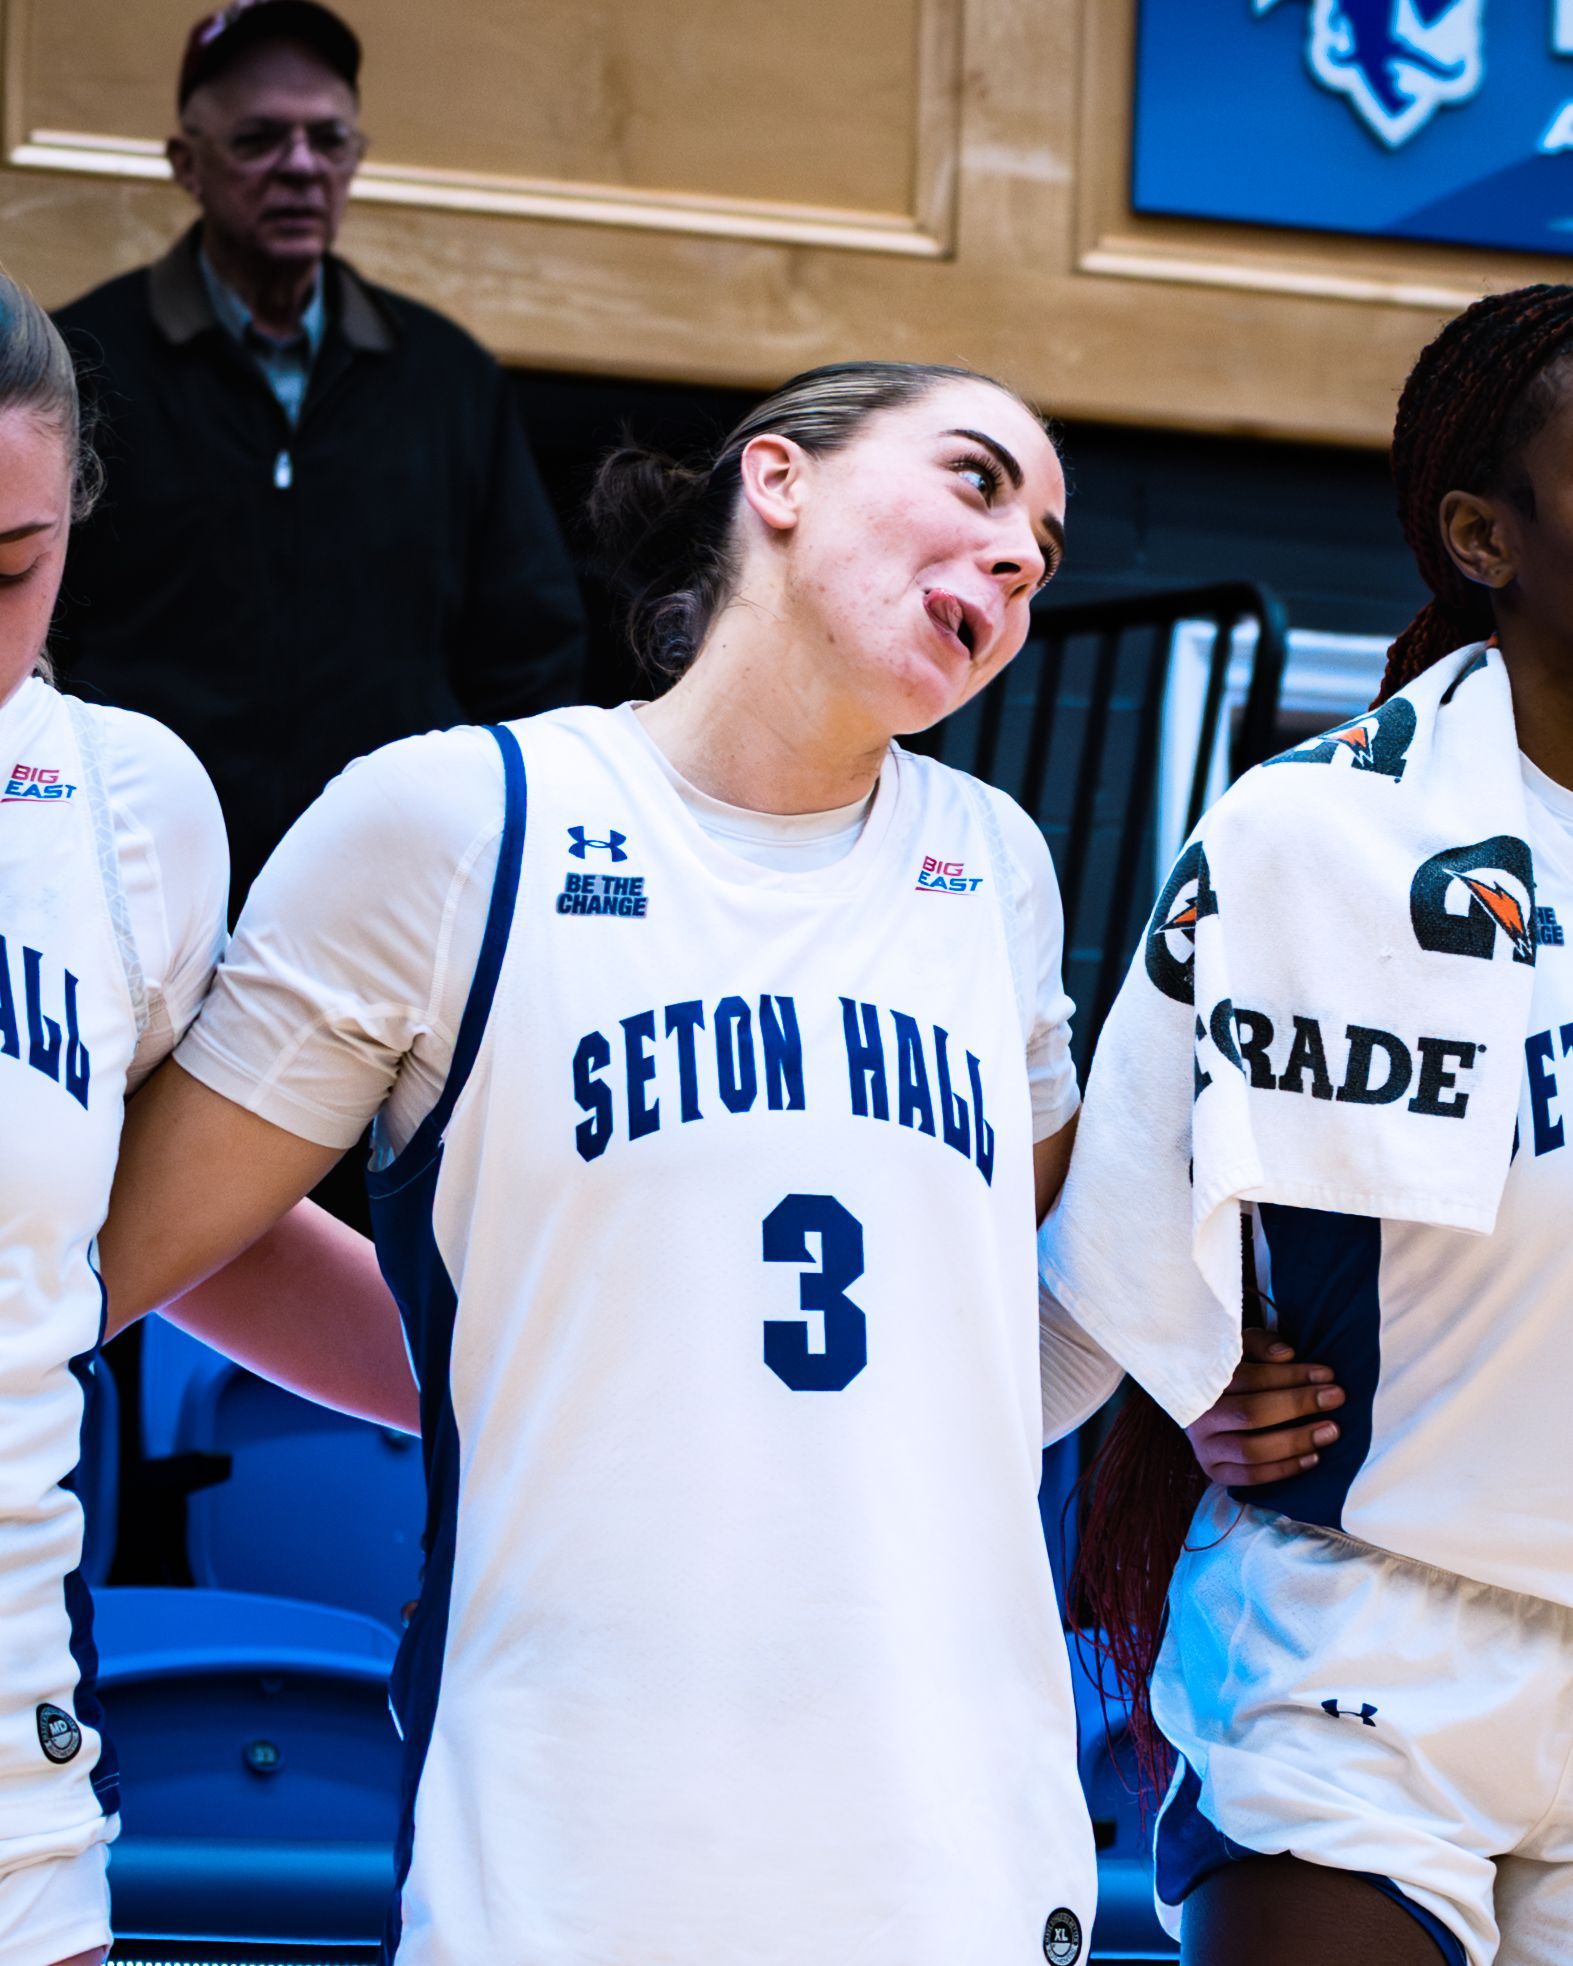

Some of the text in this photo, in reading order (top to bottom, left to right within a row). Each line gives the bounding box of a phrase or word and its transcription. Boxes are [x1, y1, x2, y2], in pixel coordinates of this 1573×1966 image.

[11, 764, 60, 785] BIG
[4, 780, 77, 799] EAST
[922, 855, 965, 877] BIG
[565, 872, 645, 897] BE THE
[917, 870, 984, 892] EAST
[556, 893, 648, 918] CHANGE
[572, 993, 995, 1188] SETON HALL
[761, 1193, 868, 1392] 3
[49, 1719, 68, 1735] MD
[1054, 1928, 1069, 1941] XL
